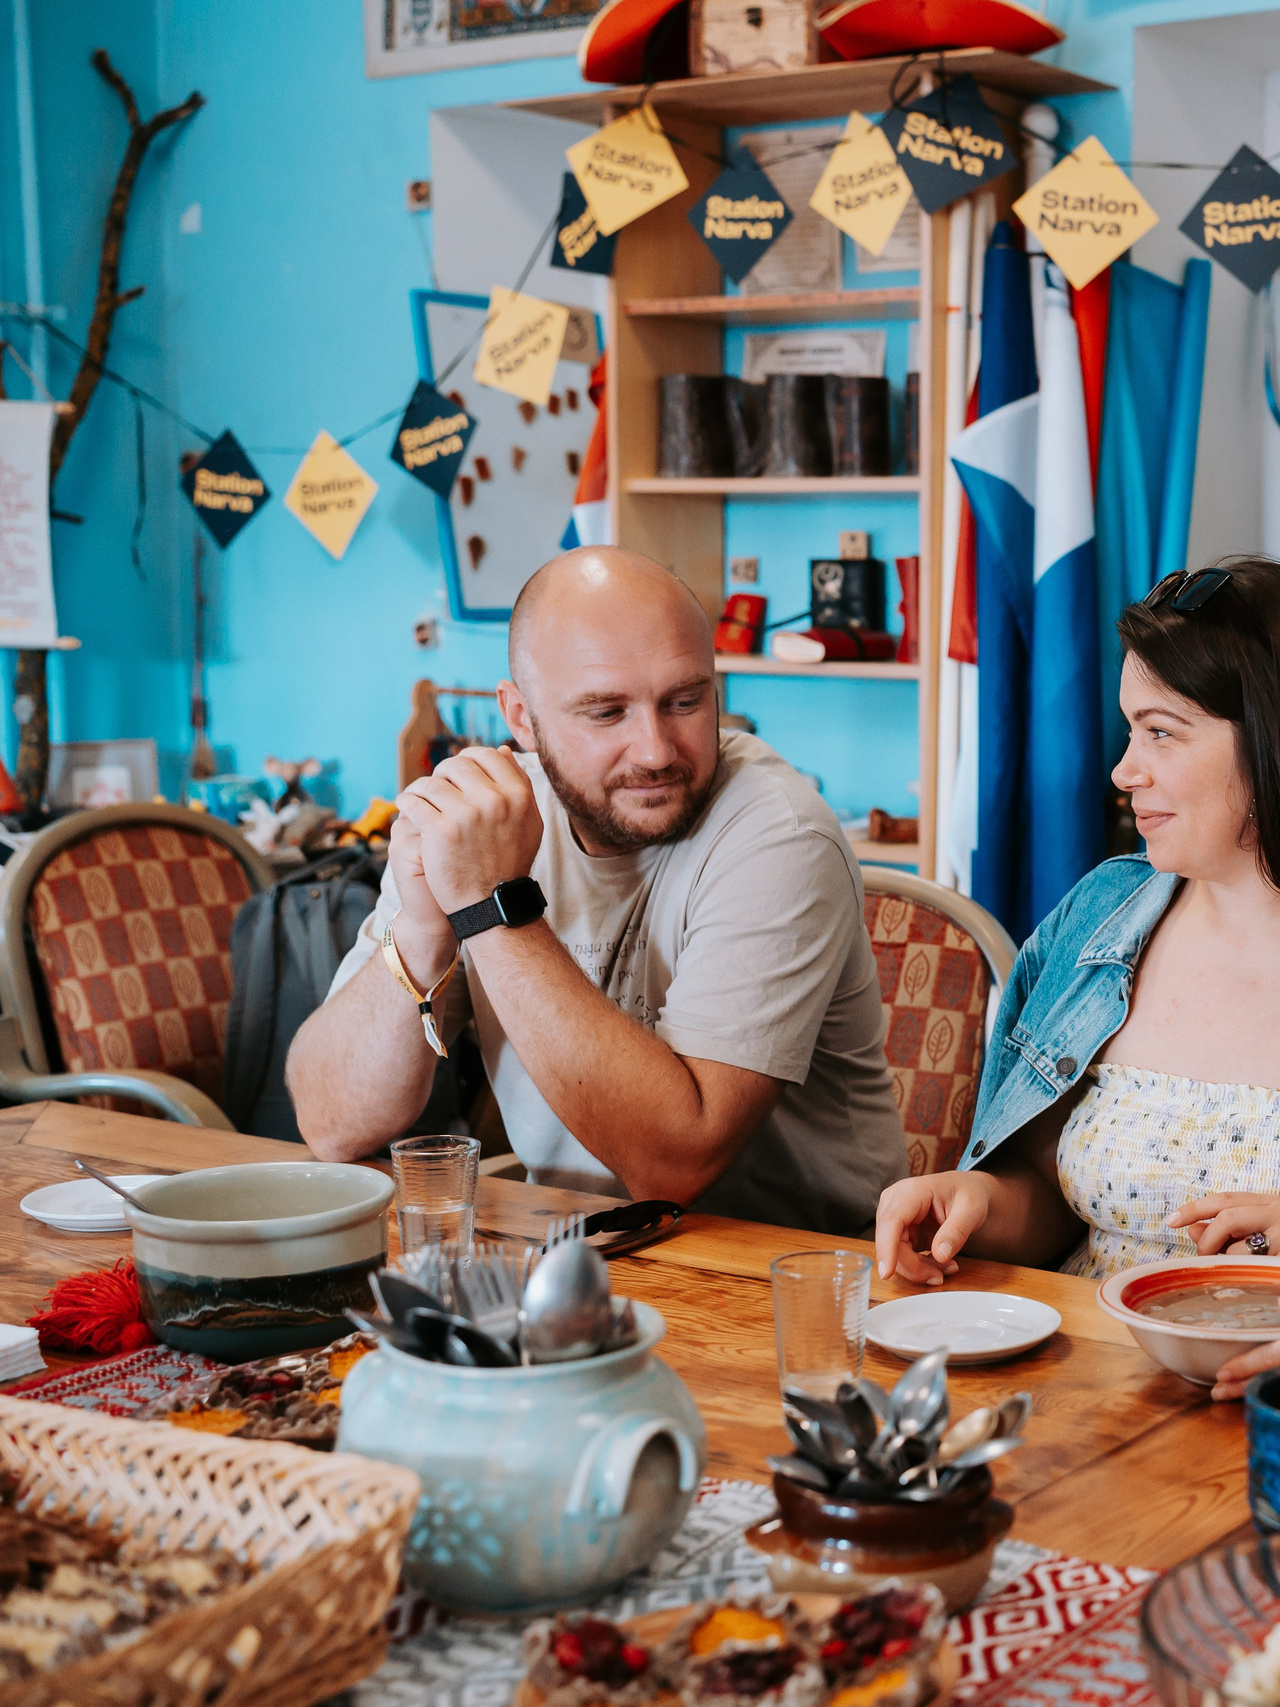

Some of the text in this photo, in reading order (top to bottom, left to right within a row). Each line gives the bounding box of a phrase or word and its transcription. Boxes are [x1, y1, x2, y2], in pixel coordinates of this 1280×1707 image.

[904, 111, 1004, 160] Station
[593, 141, 672, 179] Station
[897, 133, 985, 178] Narva
[583, 162, 654, 195] Narva
[831, 155, 900, 194] Statio
[706, 195, 785, 220] Station
[834, 179, 900, 215] Narva
[1042, 189, 1138, 216] Station
[705, 219, 773, 240] Narva
[1038, 212, 1122, 237] Narva
[490, 311, 554, 360] Station
[495, 334, 551, 379] Narva
[400, 412, 469, 451] Station
[404, 434, 463, 471] Narva
[195, 468, 263, 496] Station
[301, 477, 364, 497] Station
[194, 489, 254, 513] Narva
[303, 499, 355, 514] Narva
